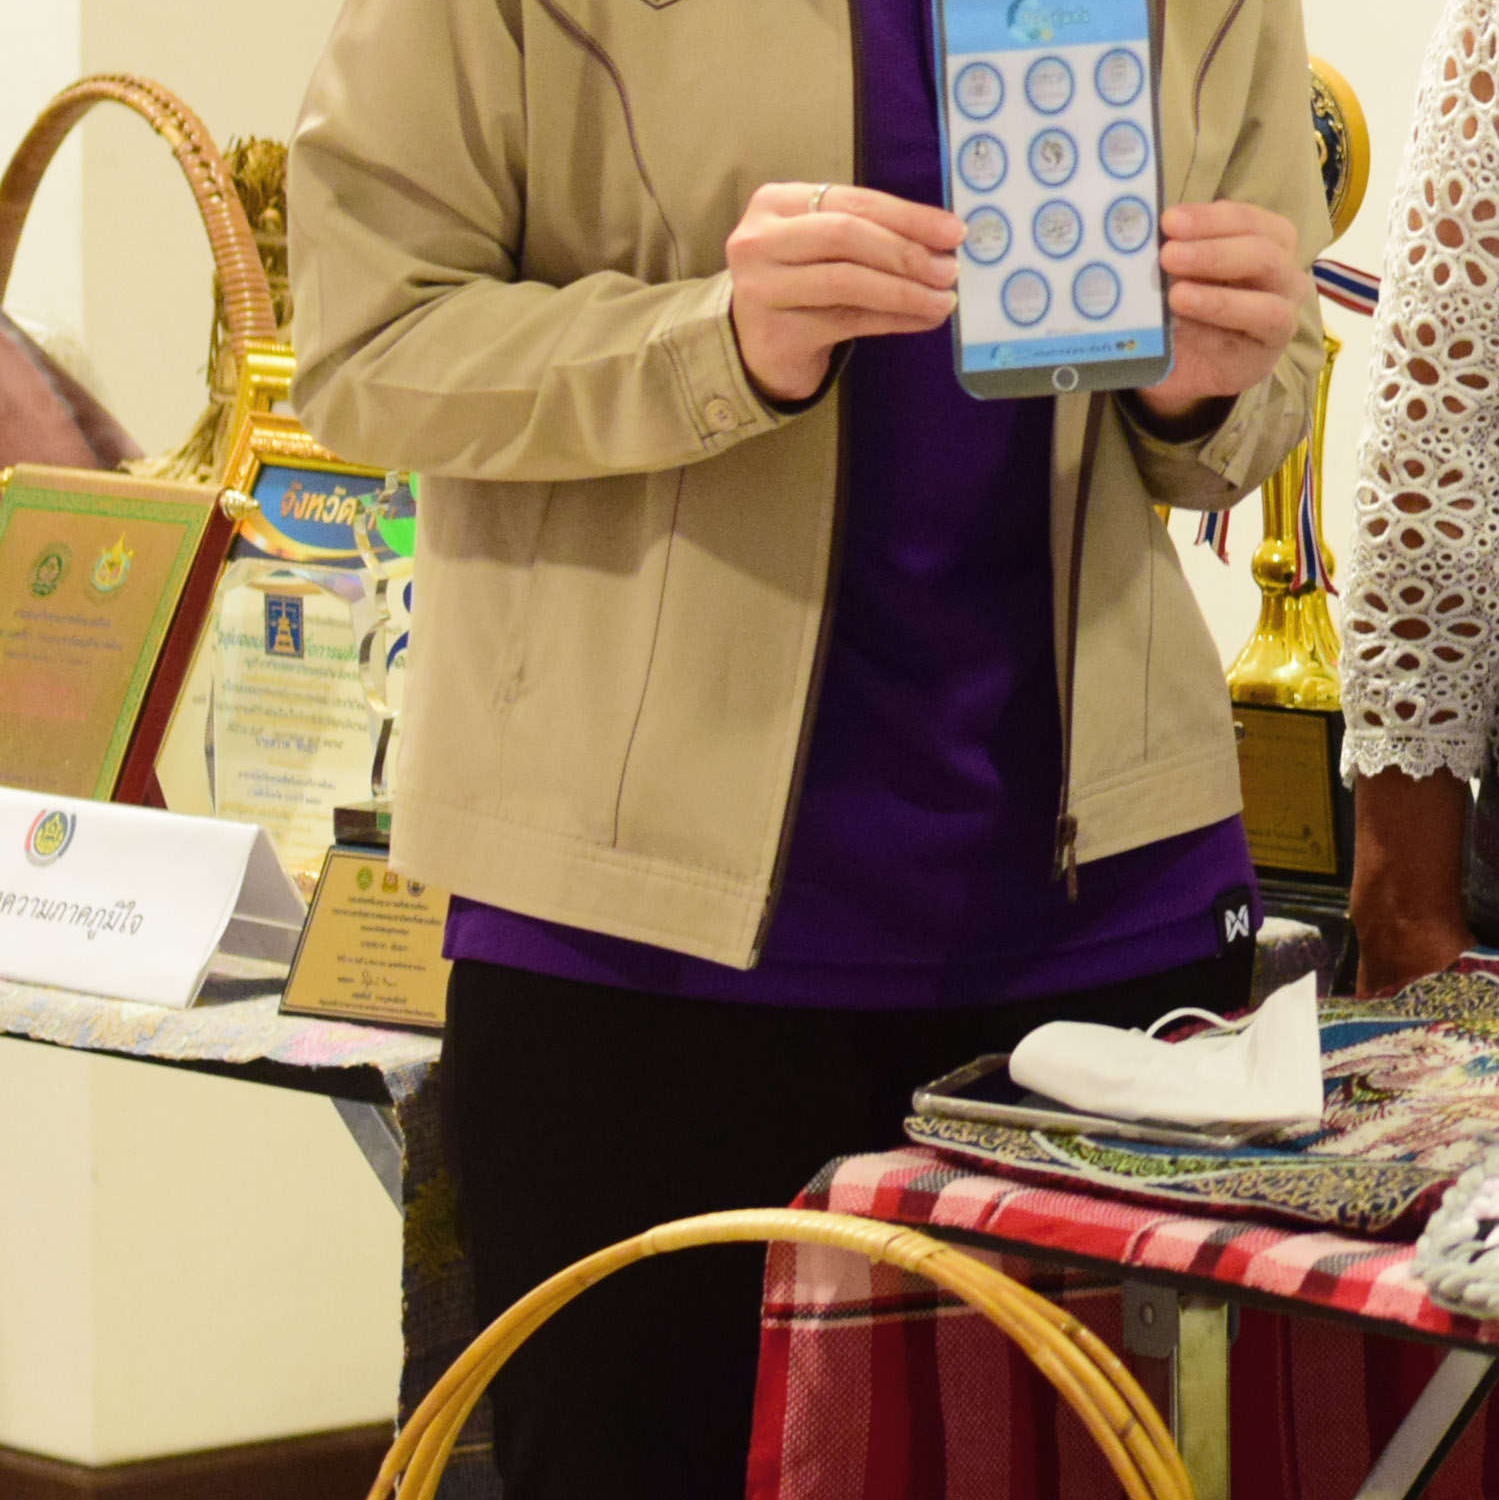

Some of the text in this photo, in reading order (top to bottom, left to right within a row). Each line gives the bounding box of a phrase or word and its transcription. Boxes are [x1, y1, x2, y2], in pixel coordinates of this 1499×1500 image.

[281, 481, 358, 526] จังหวัด
[0, 890, 144, 940] ความภาคภูมิใจ
